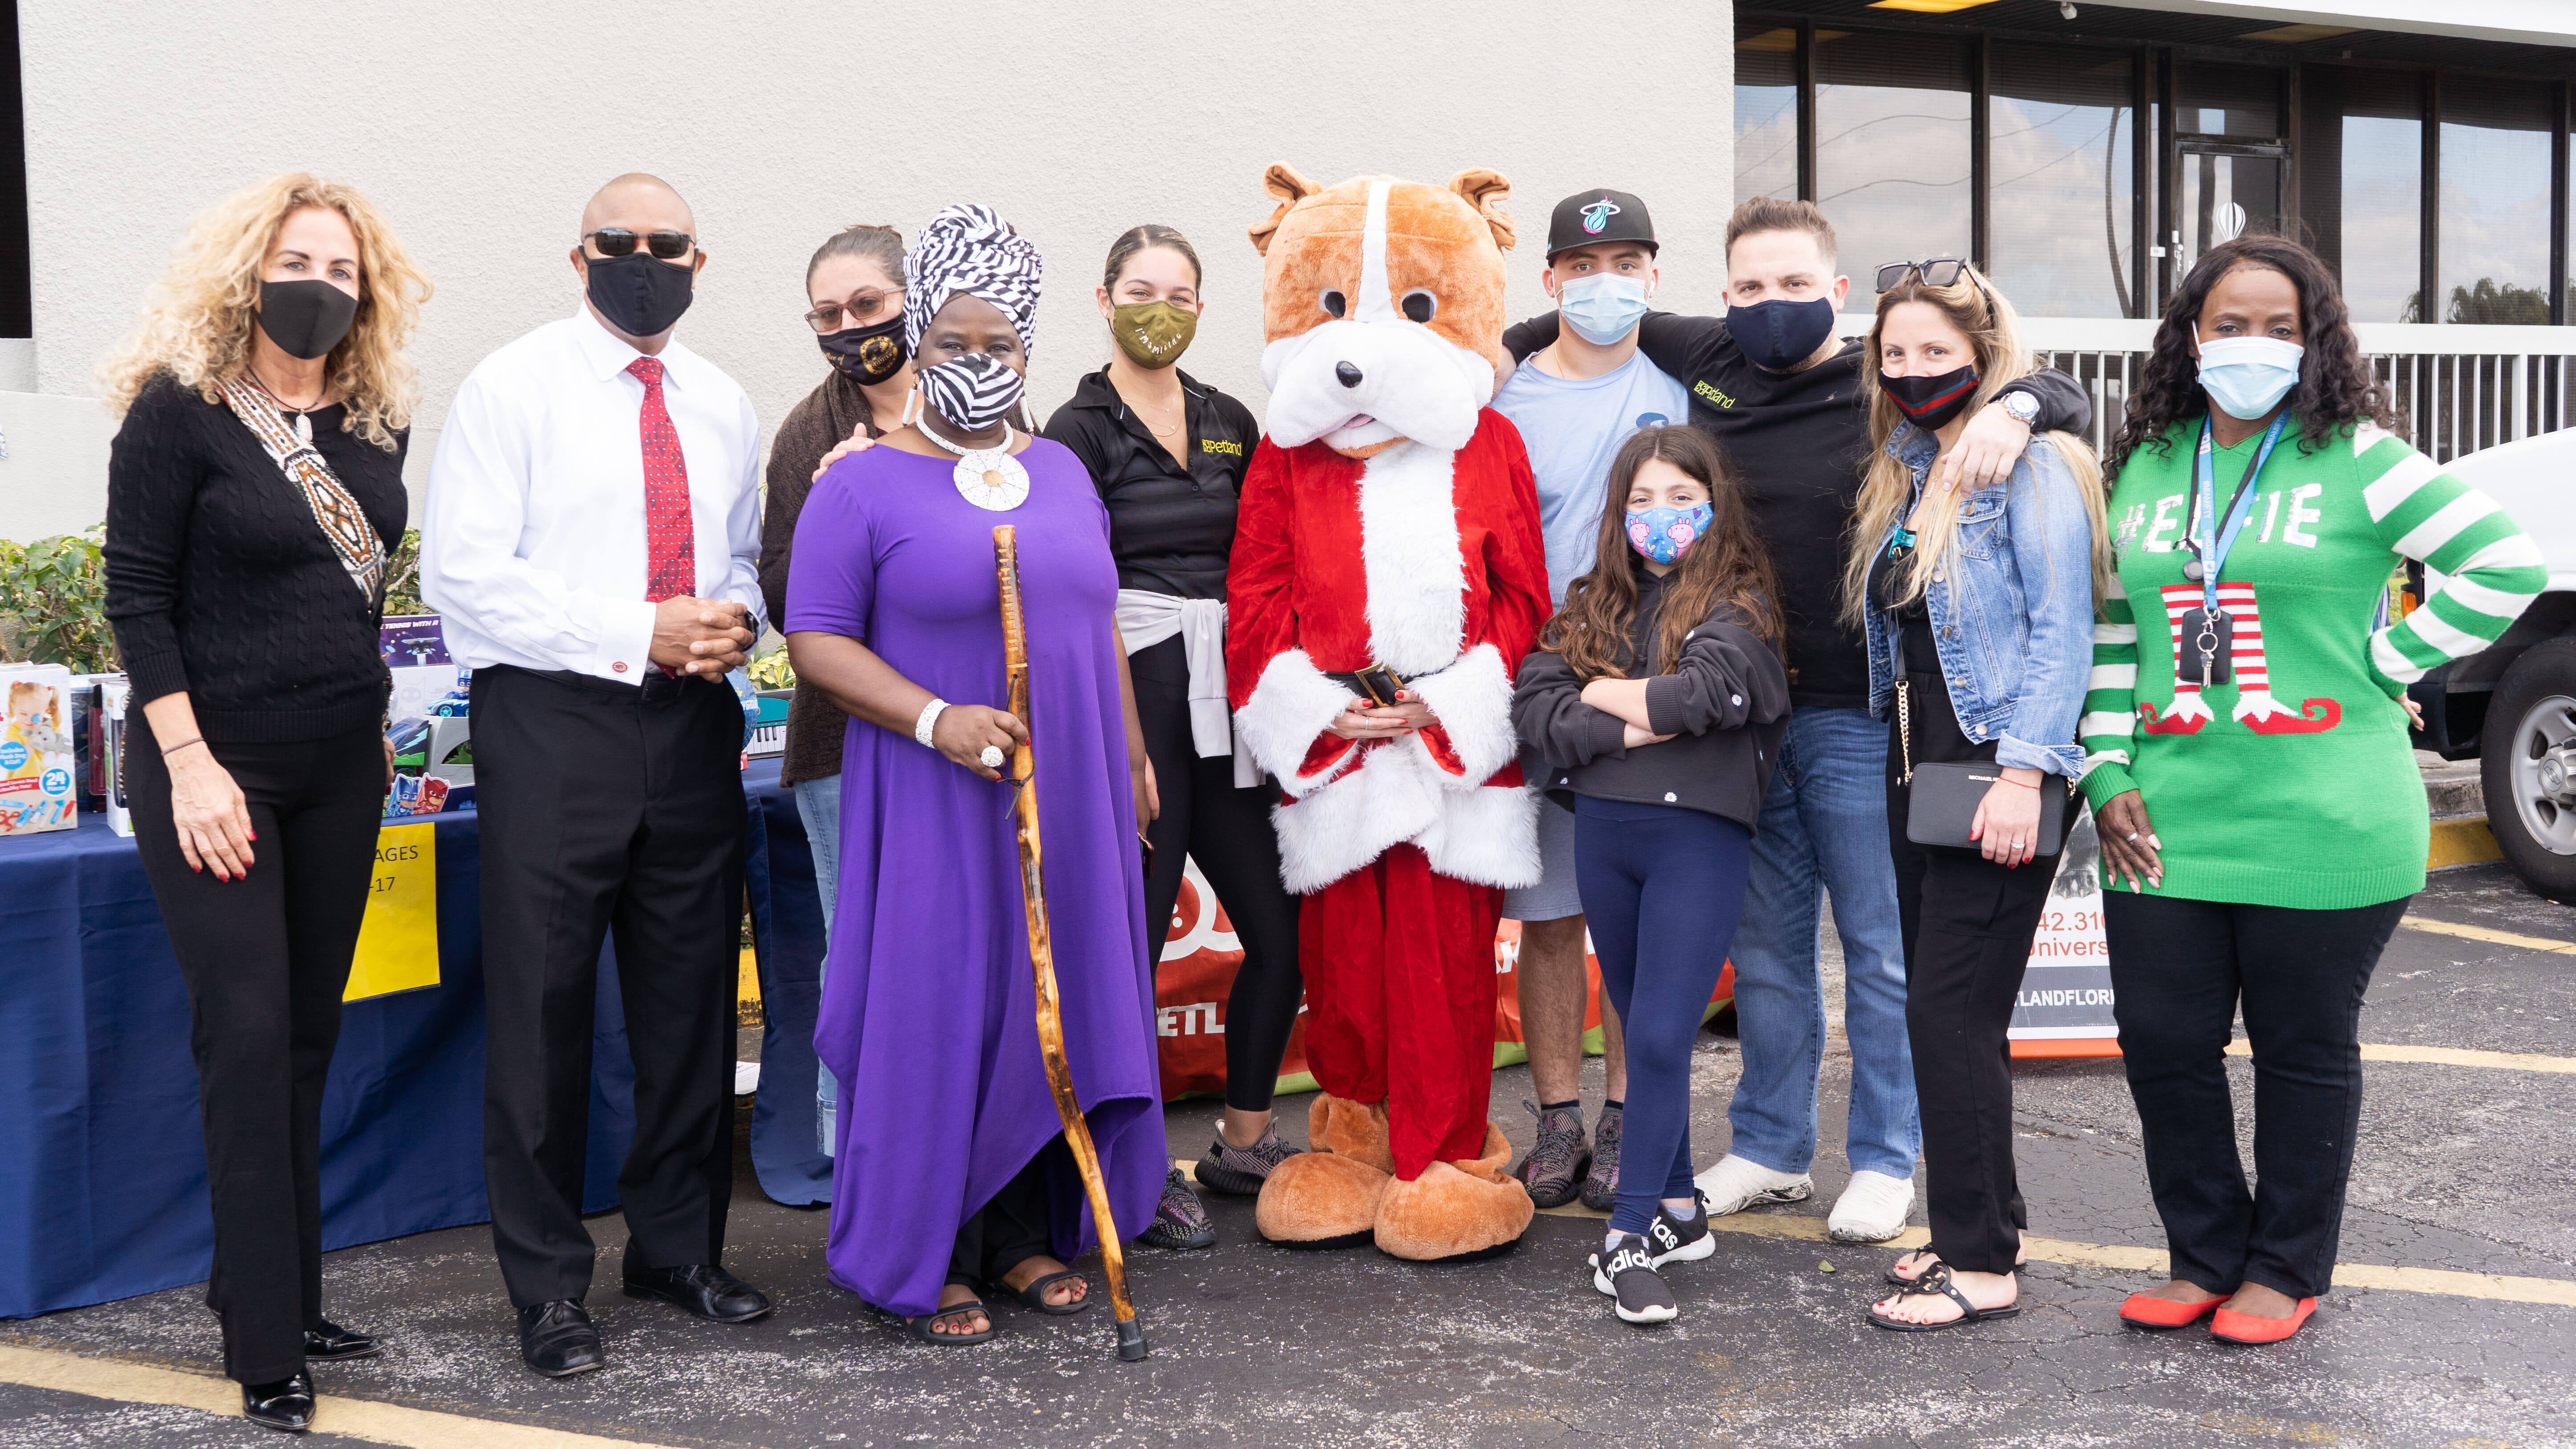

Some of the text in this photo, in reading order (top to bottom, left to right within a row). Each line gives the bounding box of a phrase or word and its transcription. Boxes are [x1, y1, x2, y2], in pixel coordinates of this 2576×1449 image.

[1210, 439, 1242, 456] Petland
[46, 771, 65, 786] 24
[374, 845, 418, 863] AGES
[2015, 989, 2114, 1007] LANDFLORI
[1157, 1002, 1225, 1036] ETL
